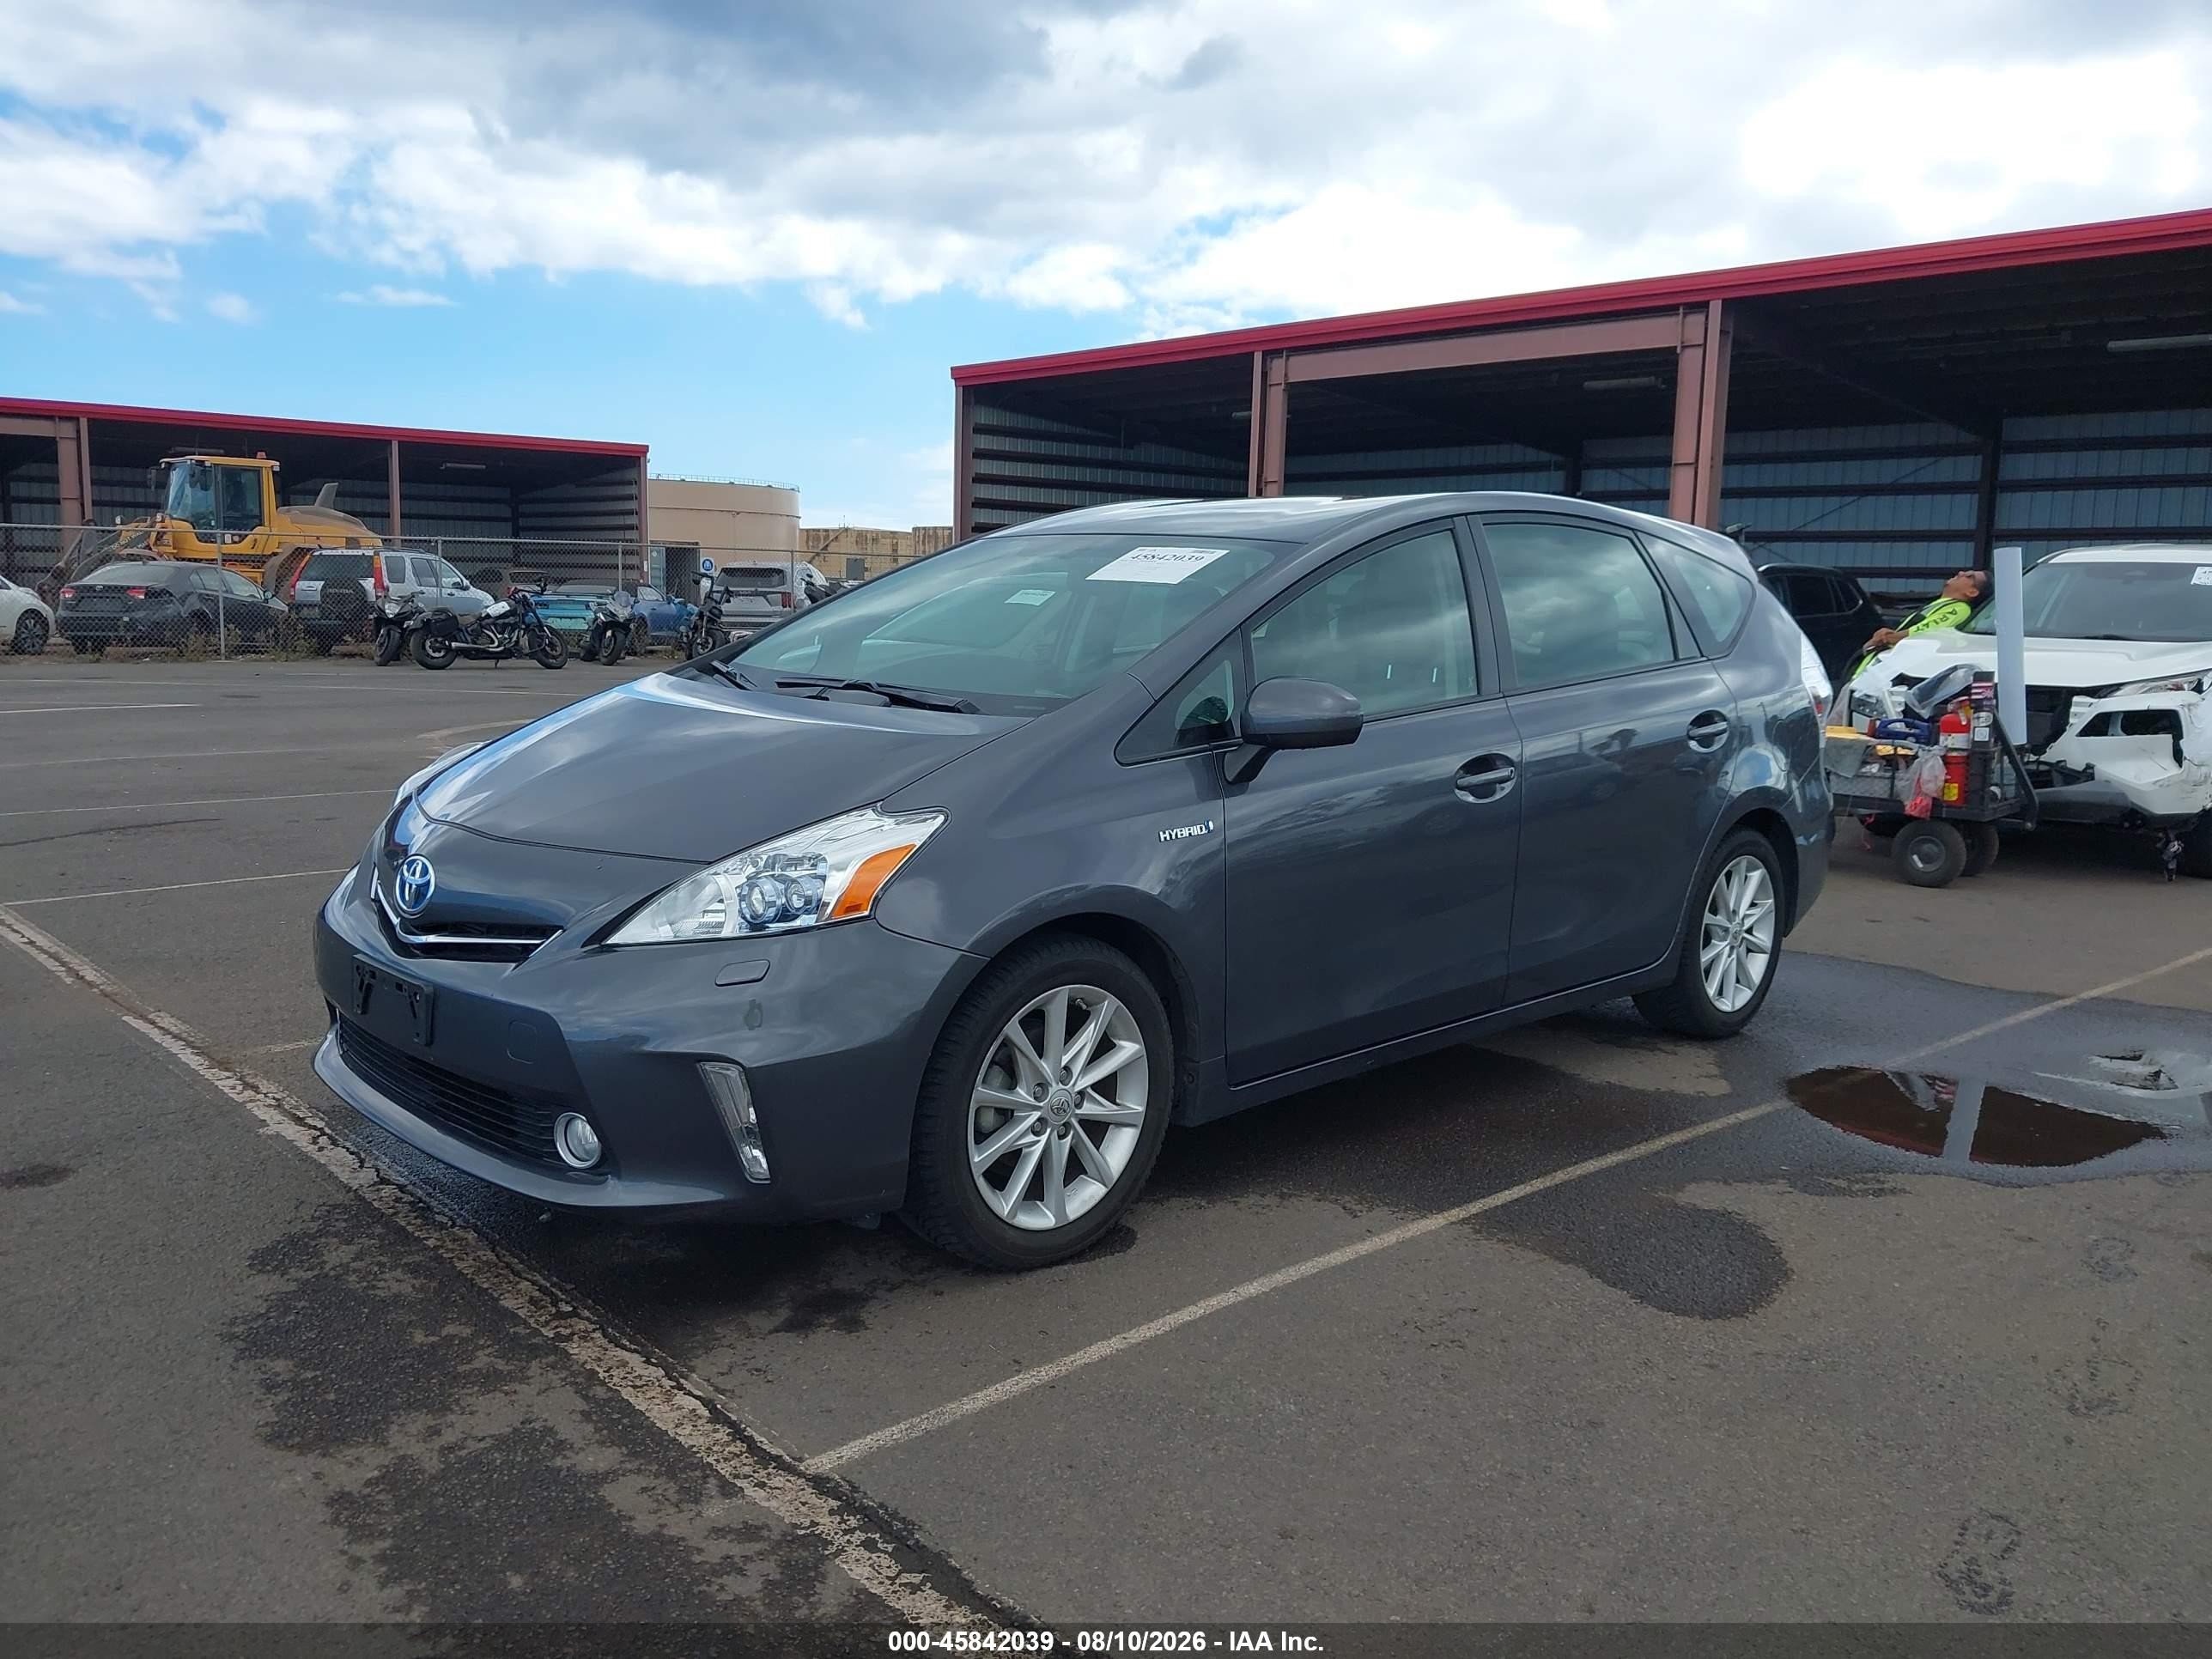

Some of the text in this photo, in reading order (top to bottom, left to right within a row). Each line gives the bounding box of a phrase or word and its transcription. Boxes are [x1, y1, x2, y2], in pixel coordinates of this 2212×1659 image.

[1130, 553, 1205, 562] 45842039
[1913, 607, 1959, 633] ARIAT
[1159, 823, 1207, 842] HYBRID
